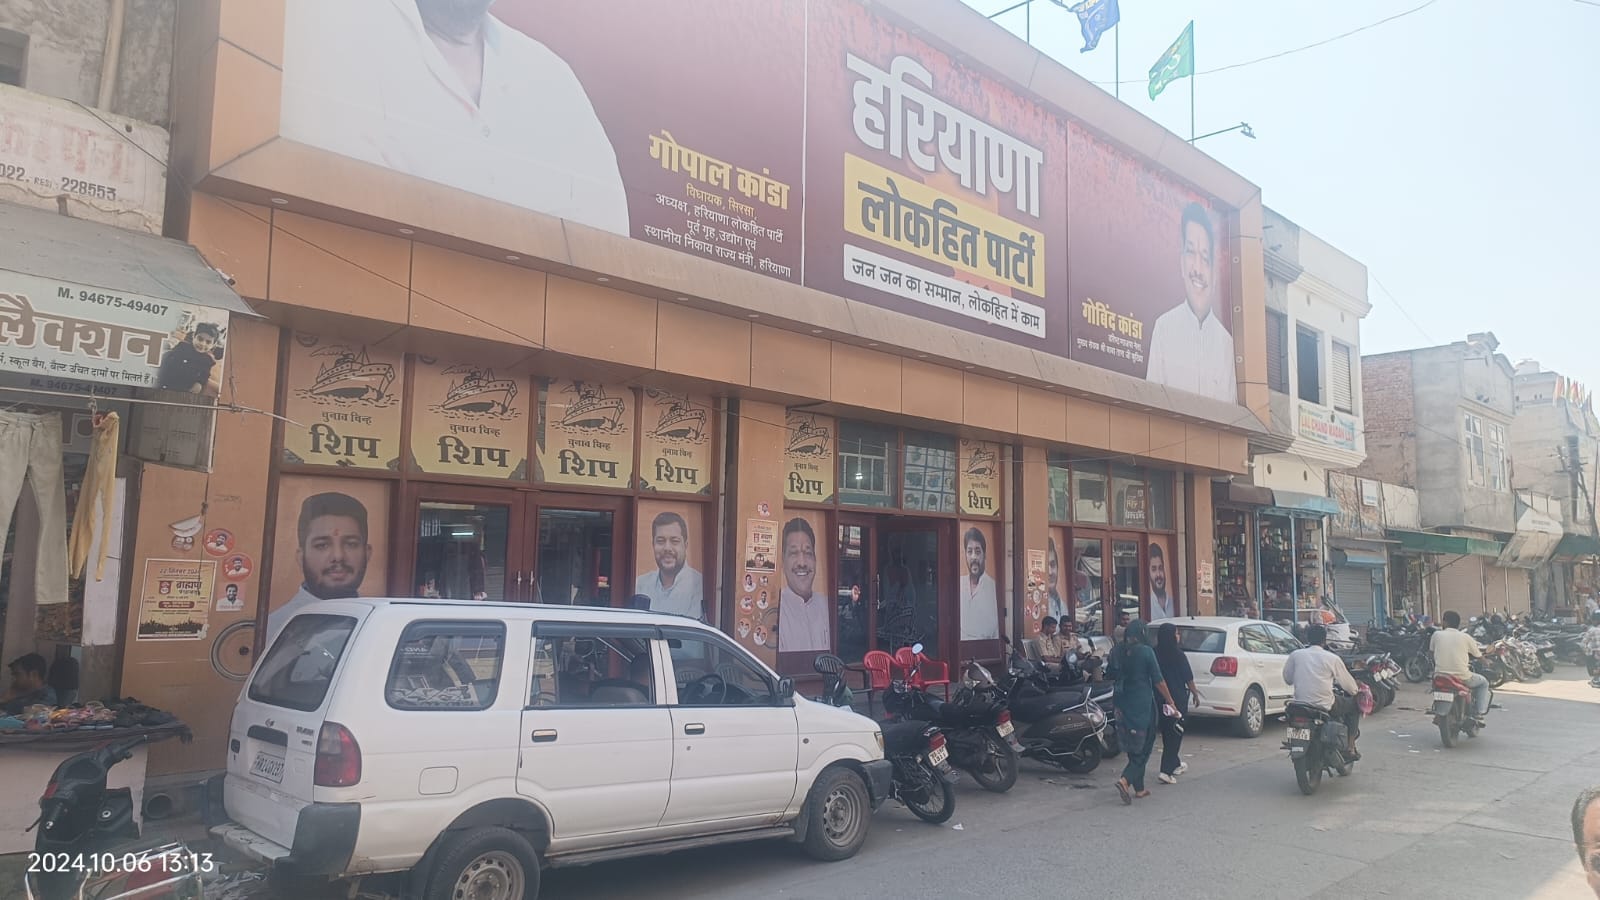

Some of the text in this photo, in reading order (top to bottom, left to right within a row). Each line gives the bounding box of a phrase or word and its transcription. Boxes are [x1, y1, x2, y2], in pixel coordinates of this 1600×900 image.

[847, 52, 1043, 218] हरियाणा
[649, 129, 790, 210] गोपाल कांडा
[61, 177, 117, 200] 228553
[687, 219, 700, 236] पूर्व
[745, 238, 757, 251] एवं
[694, 204, 728, 225] हरियाणा
[731, 217, 765, 238] लोकहित
[858, 177, 1035, 287] लोकहित पार्टी
[644, 224, 681, 246] स्थानीय
[684, 234, 713, 255] निकाय
[715, 245, 736, 261] राज्य
[759, 257, 791, 278] हरियाणा
[57, 286, 169, 316] M. 94675-49407
[852, 258, 876, 280] जन
[880, 266, 902, 287] जन
[906, 275, 921, 293] का
[925, 280, 965, 310] सम्मान,
[969, 289, 1008, 321] लोकहित
[1021, 314, 1039, 329] काम
[1118, 312, 1143, 339] कांडा
[9, 356, 30, 369] स्कूल
[110, 370, 119, 379] पर
[322, 410, 372, 425] चुनाव चिन्ह
[449, 423, 500, 436] चुनाव चिन्ह
[309, 424, 381, 458] शिप
[437, 436, 510, 467] शिप
[558, 449, 619, 478] शिप
[655, 457, 698, 484] शिप
[788, 472, 824, 495] शिप
[968, 490, 992, 509] शिप
